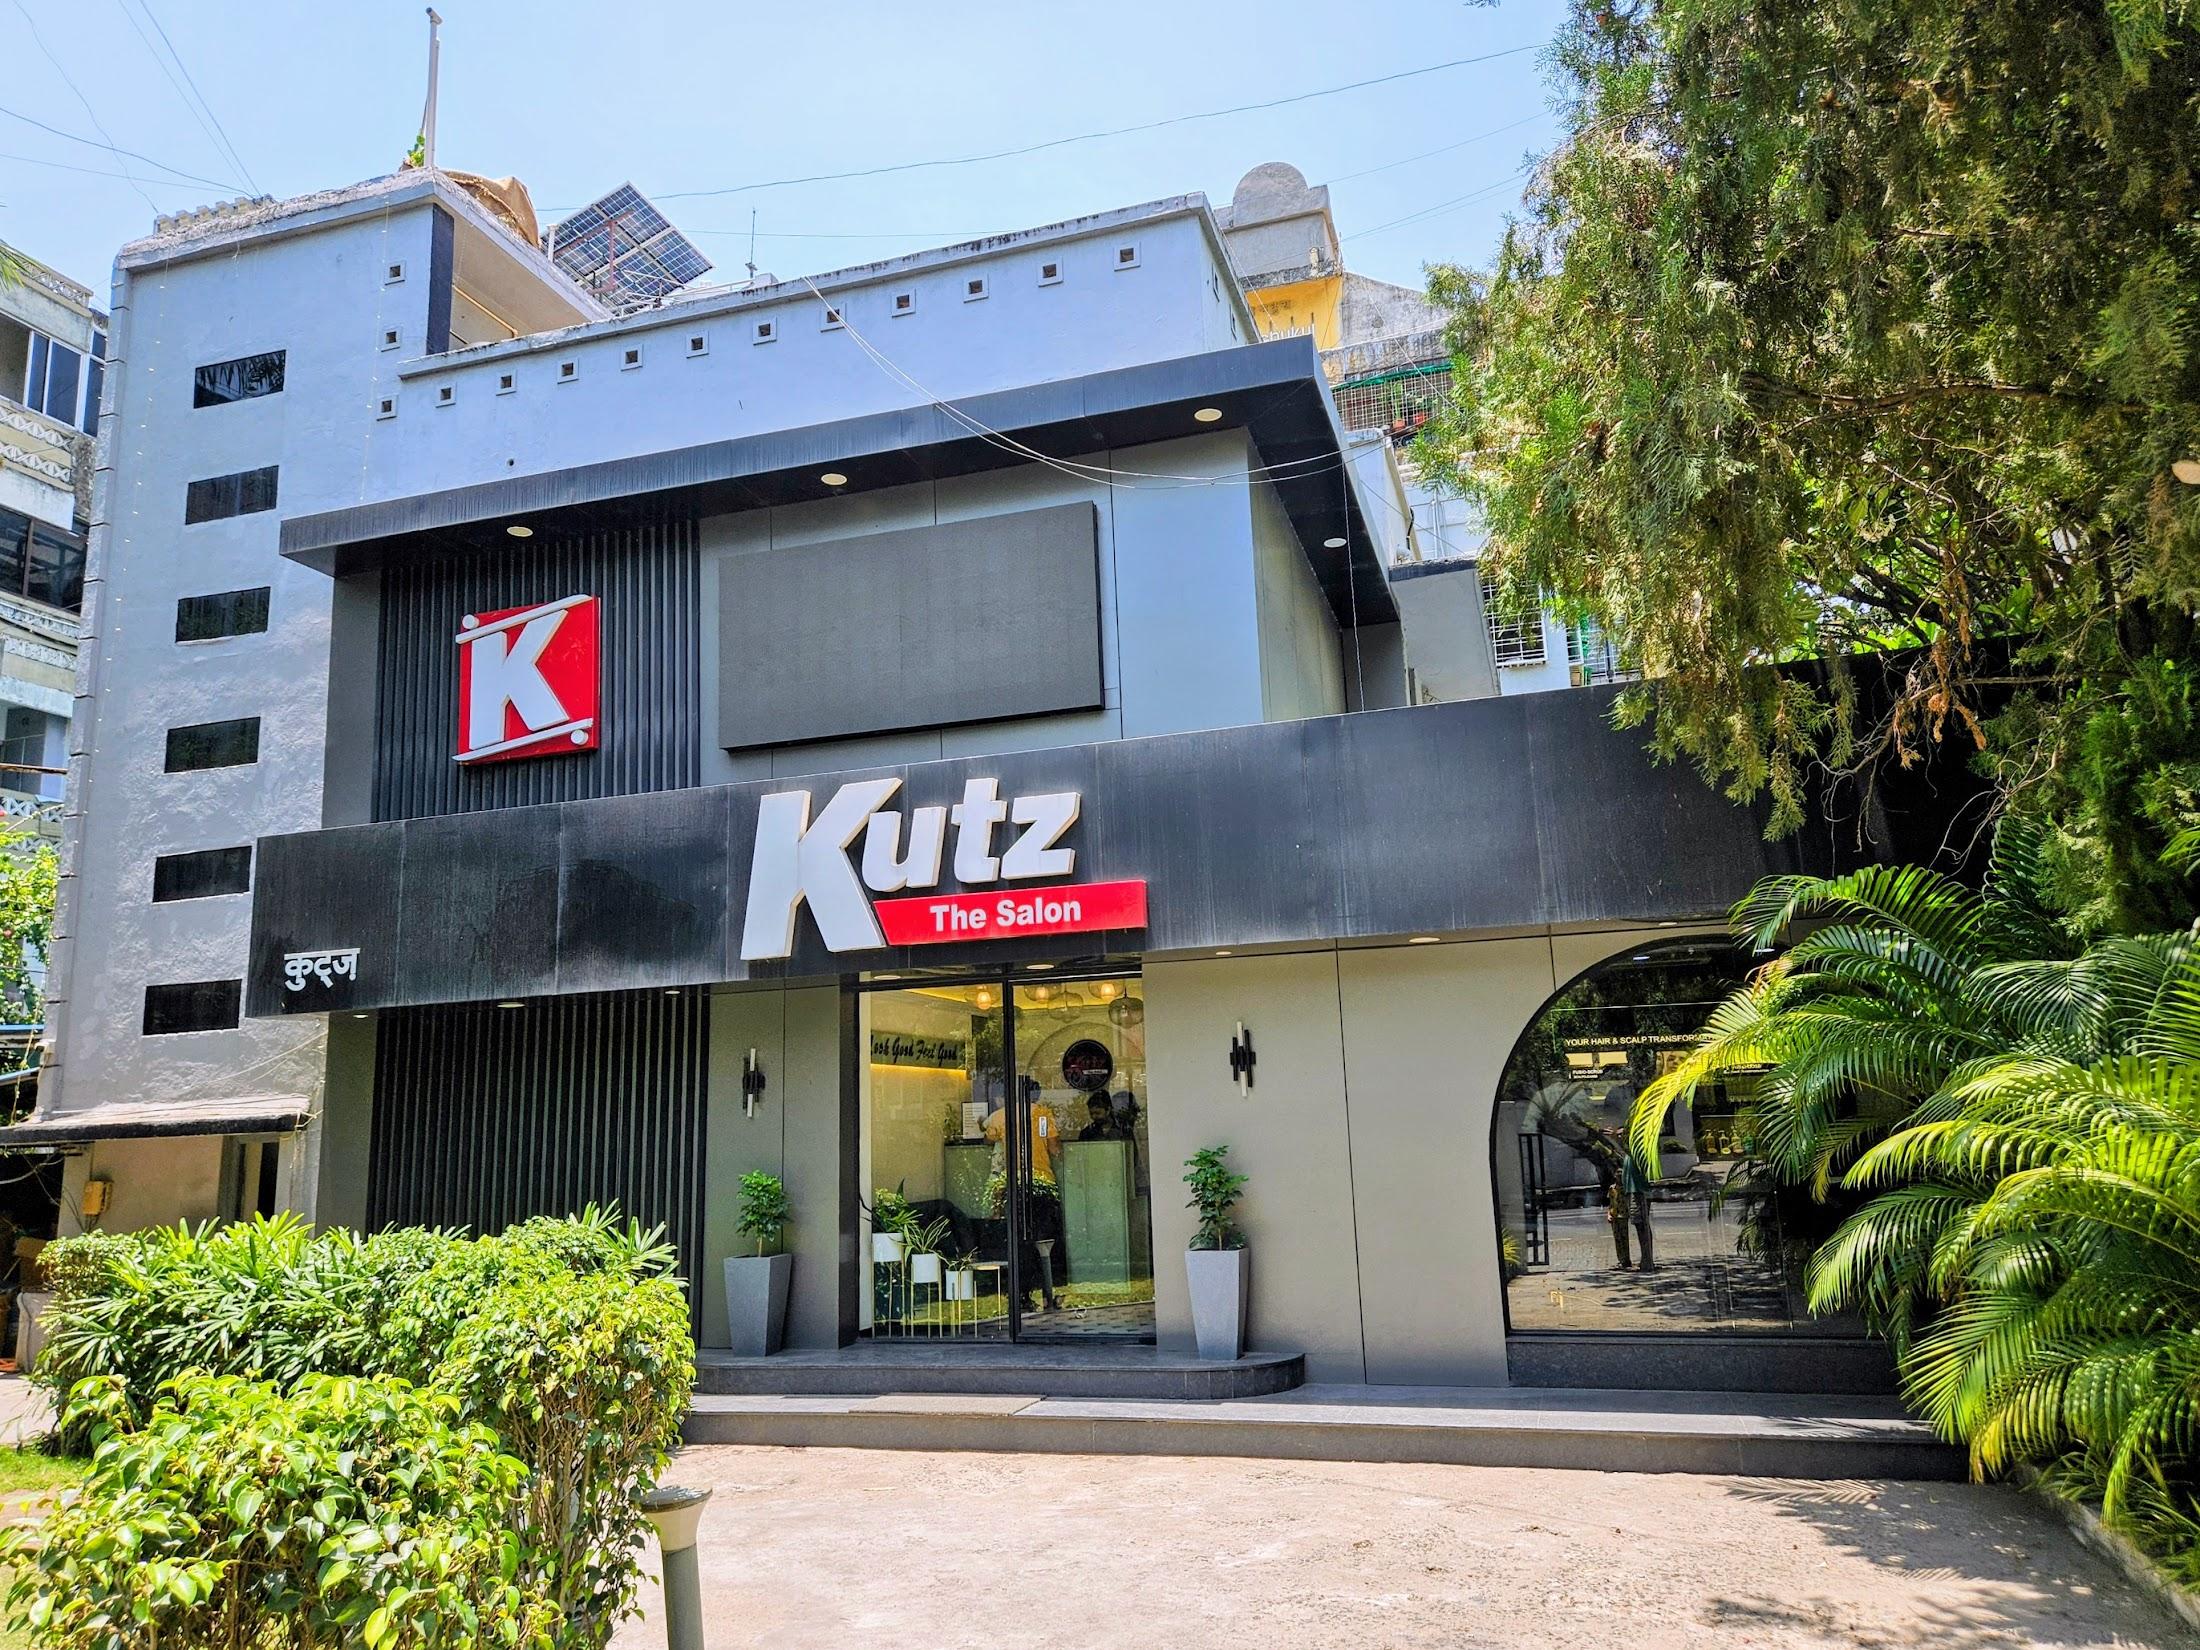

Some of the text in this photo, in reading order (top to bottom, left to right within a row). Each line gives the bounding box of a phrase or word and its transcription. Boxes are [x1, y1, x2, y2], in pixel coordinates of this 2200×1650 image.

[469, 608, 570, 751] K
[741, 777, 1081, 960] Kutz
[930, 896, 1082, 932] The Salon
[1565, 1038, 1589, 1046] YOUR
[1591, 1037, 1611, 1045] HAIR
[1612, 1037, 1618, 1045] &
[1620, 1036, 1647, 1044] SCALP
